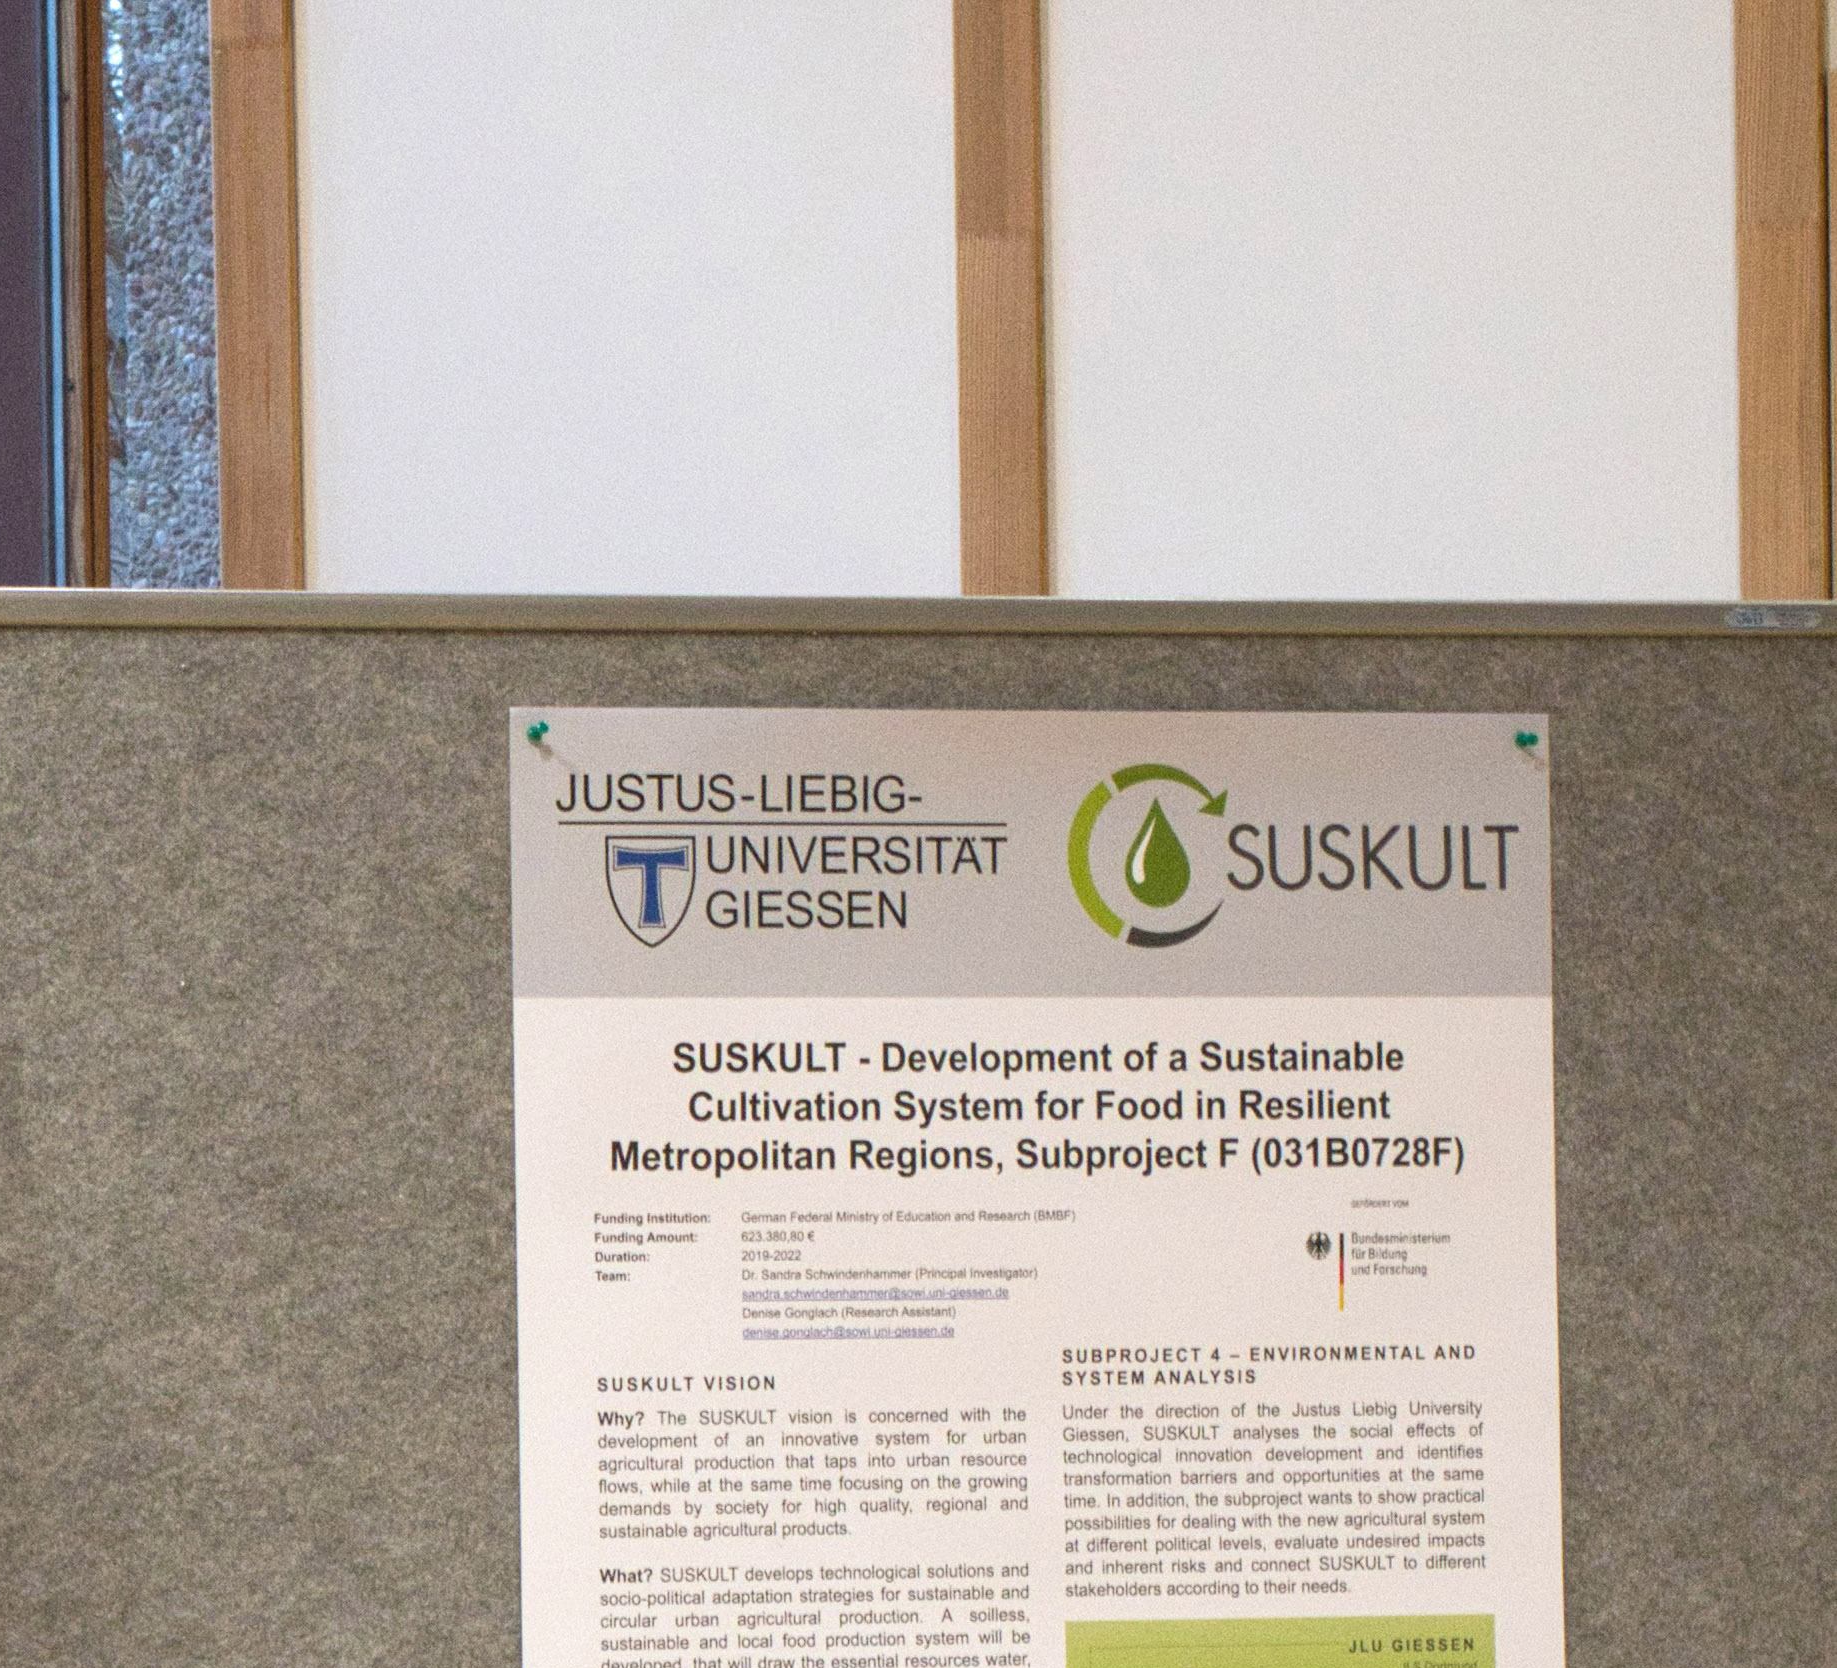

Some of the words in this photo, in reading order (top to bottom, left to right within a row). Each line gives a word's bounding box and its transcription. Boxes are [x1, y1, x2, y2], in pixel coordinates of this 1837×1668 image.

[555, 772, 923, 814] JUSTUS-LIEBIG-
[1227, 823, 1519, 891] SUSKULT
[705, 889, 907, 930] GIESSEN
[673, 1041, 847, 1074] SUSKULT
[882, 1041, 1113, 1081] Development
[1123, 1041, 1159, 1073] of
[1169, 1048, 1187, 1072] a
[1200, 1040, 1404, 1072] Sustainable
[688, 1090, 881, 1122] Cultivation
[894, 1090, 1023, 1129] System
[1034, 1089, 1085, 1121] for
[1096, 1089, 1183, 1121] Food
[1196, 1089, 1226, 1120] in
[1239, 1089, 1391, 1120] Resilient
[611, 1139, 836, 1179] Metropolitan
[849, 1139, 1003, 1178] Regions,
[1016, 1138, 1207, 1177] Subproject
[1219, 1137, 1239, 1168] F
[1251, 1136, 1465, 1176] (031B0728F)
[593, 1212, 644, 1227] Funding
[646, 1212, 710, 1224] Institution:
[593, 1231, 644, 1246] Funding
[646, 1231, 697, 1244] Amount:
[740, 1230, 804, 1244] 623.380,80
[806, 1230, 816, 1243] €
[594, 1250, 648, 1263] Duration:
[741, 1249, 802, 1262] 2019-2022
[595, 1269, 628, 1282] Team:
[1062, 1347, 1201, 1364] SUBPROJECT
[1210, 1347, 1221, 1362] 4
[1249, 1345, 1425, 1362] ENVIRONMENTAL
[1434, 1344, 1476, 1360] AND
[597, 1375, 694, 1393] SUSKULT
[703, 1375, 776, 1392] VISION
[1062, 1369, 1145, 1387] SYSTEM
[1154, 1368, 1256, 1385] ANALYSIS
[1348, 1639, 1383, 1654] JLU
[1391, 1637, 1475, 1653] GIESSEN
